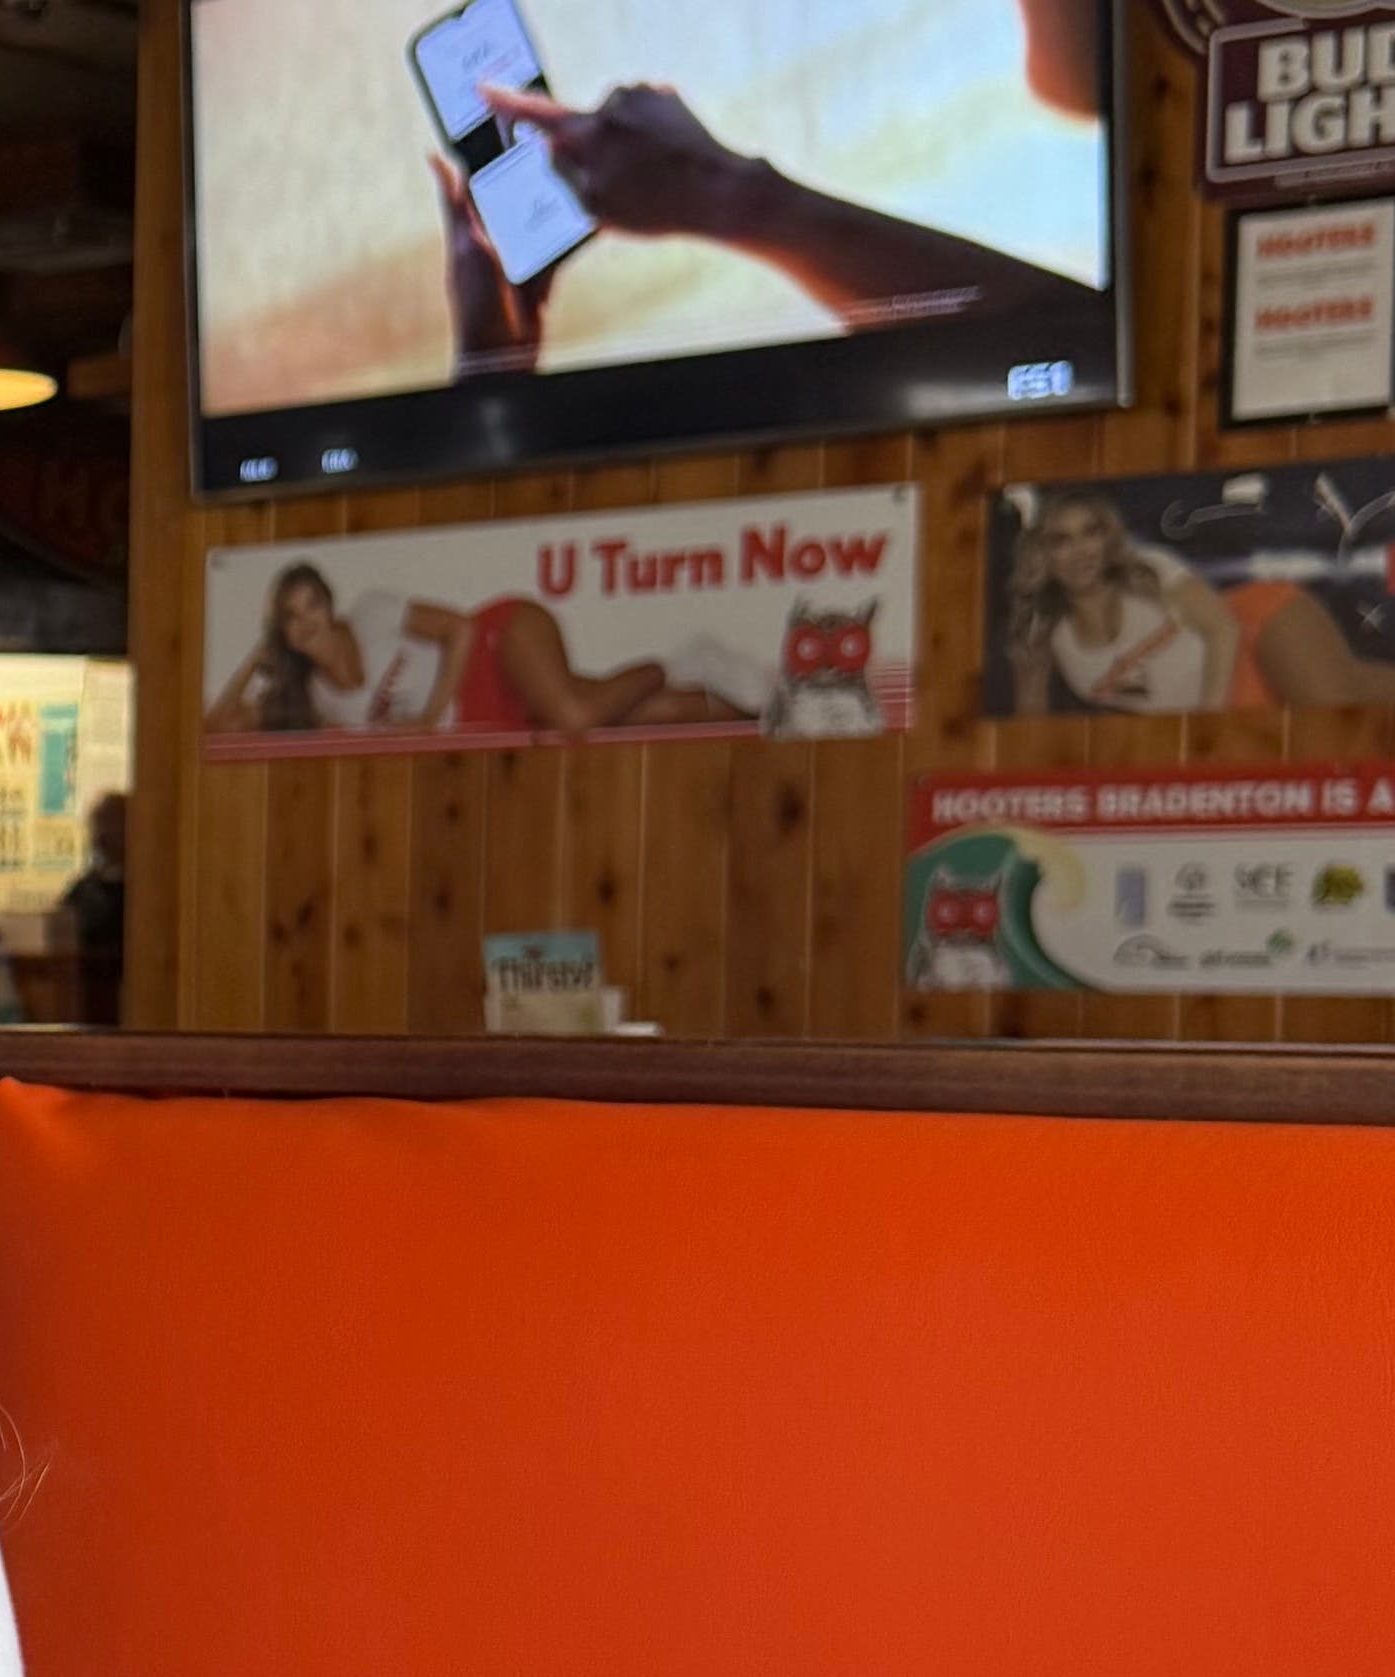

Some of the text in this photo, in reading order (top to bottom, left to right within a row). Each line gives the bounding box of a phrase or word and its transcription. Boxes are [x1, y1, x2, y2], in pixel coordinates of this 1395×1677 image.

[538, 523, 889, 599] U Turn Now
[932, 785, 1087, 824] HOOTERS
[1095, 780, 1312, 821] BRADENTON
[1322, 777, 1358, 816] IS
